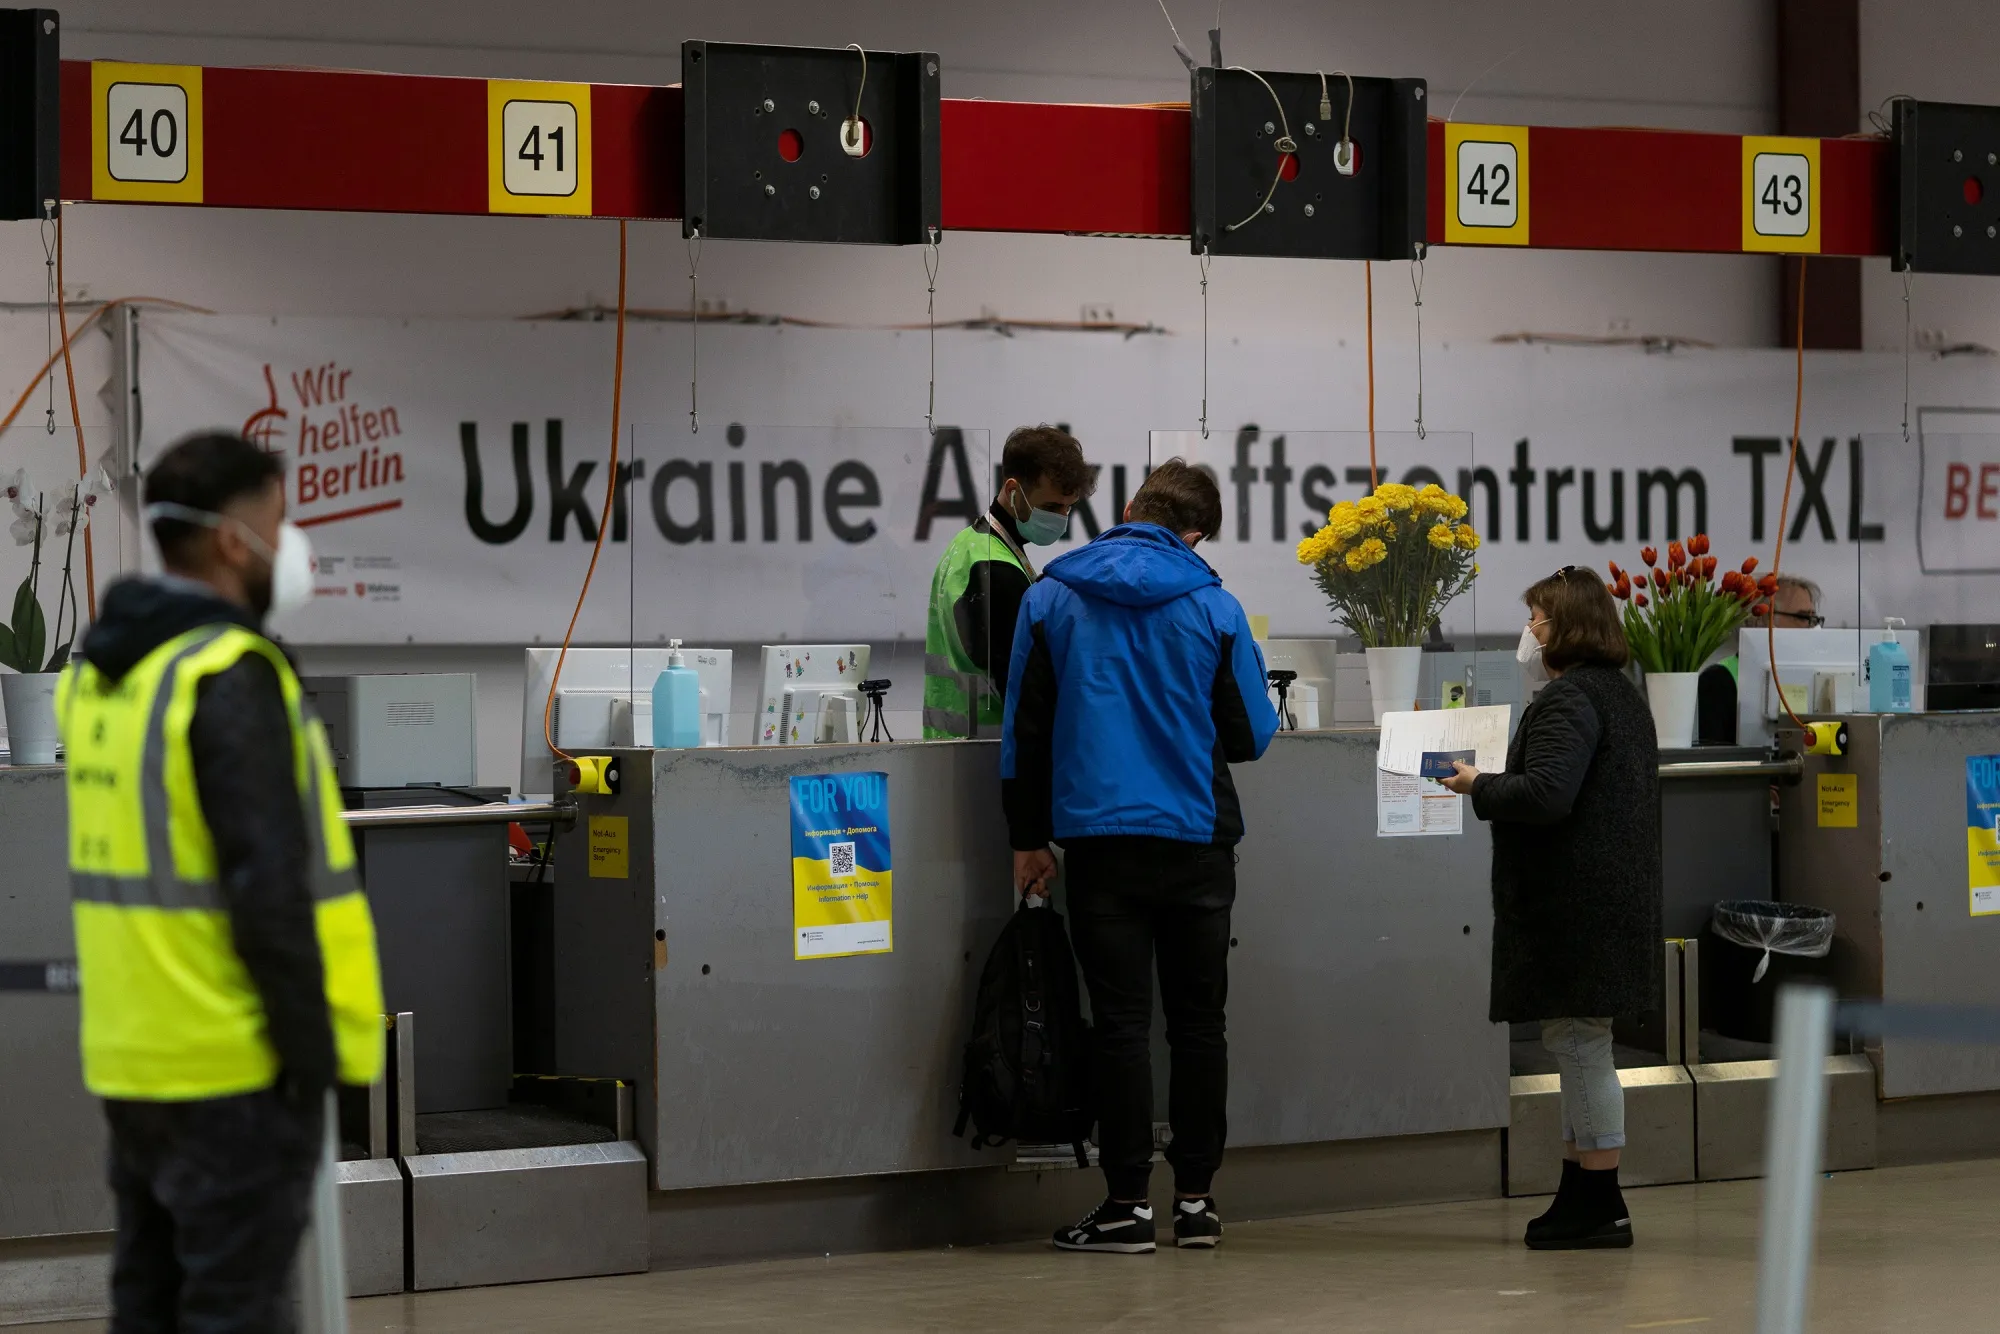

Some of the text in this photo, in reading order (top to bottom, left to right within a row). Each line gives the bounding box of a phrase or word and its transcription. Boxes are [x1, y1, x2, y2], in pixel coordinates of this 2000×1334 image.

[119, 108, 178, 159] 40
[517, 125, 566, 173] 41
[1466, 163, 1511, 206] 42
[1761, 174, 1803, 216] 43
[291, 361, 352, 408] Wir
[298, 403, 402, 457] helfen
[297, 447, 405, 505] Berlin
[459, 419, 883, 545] Ukraine
[1732, 436, 1885, 544] TXL
[797, 775, 881, 815] FOR YOU
[592, 829, 616, 838] Not-Aus
[592, 846, 621, 855] Emergency
[818, 894, 851, 903] Information
